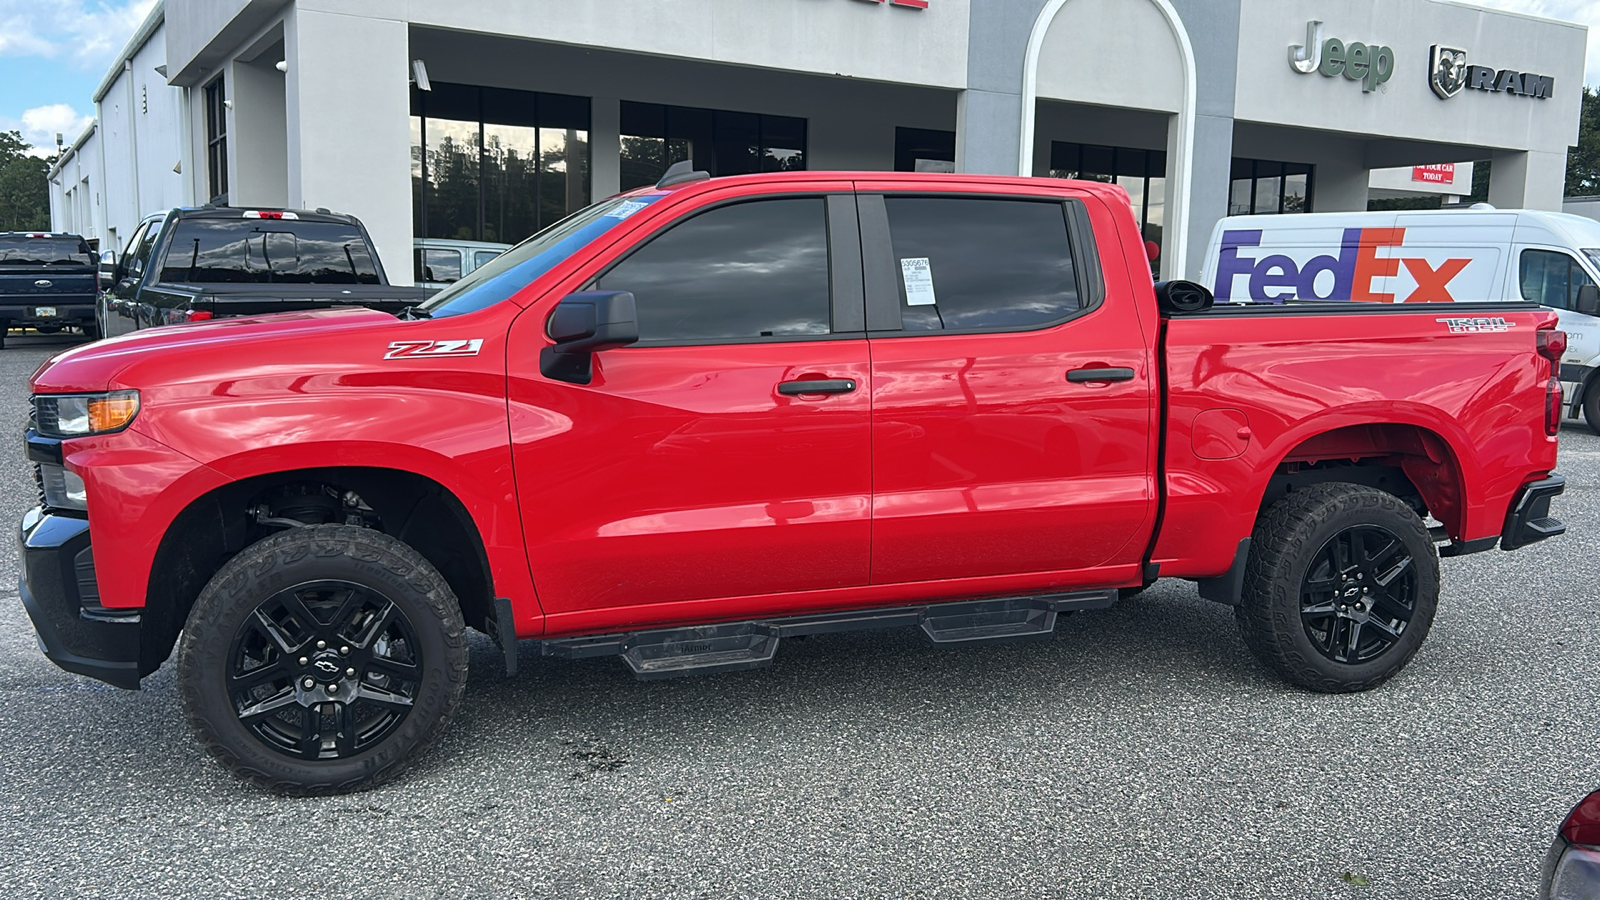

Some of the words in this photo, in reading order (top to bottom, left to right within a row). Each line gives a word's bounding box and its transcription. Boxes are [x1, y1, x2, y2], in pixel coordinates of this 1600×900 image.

[1288, 20, 1394, 92] Jeep
[1465, 65, 1554, 98] RAM
[1423, 172, 1442, 180] TODAY
[1442, 164, 1453, 172] CAR
[1213, 227, 1473, 303] FedEx
[1436, 318, 1516, 327] TRAIL
[1449, 325, 1508, 333] BOSS
[383, 339, 484, 360] Z71
[361, 667, 443, 771] GOODYEAR
